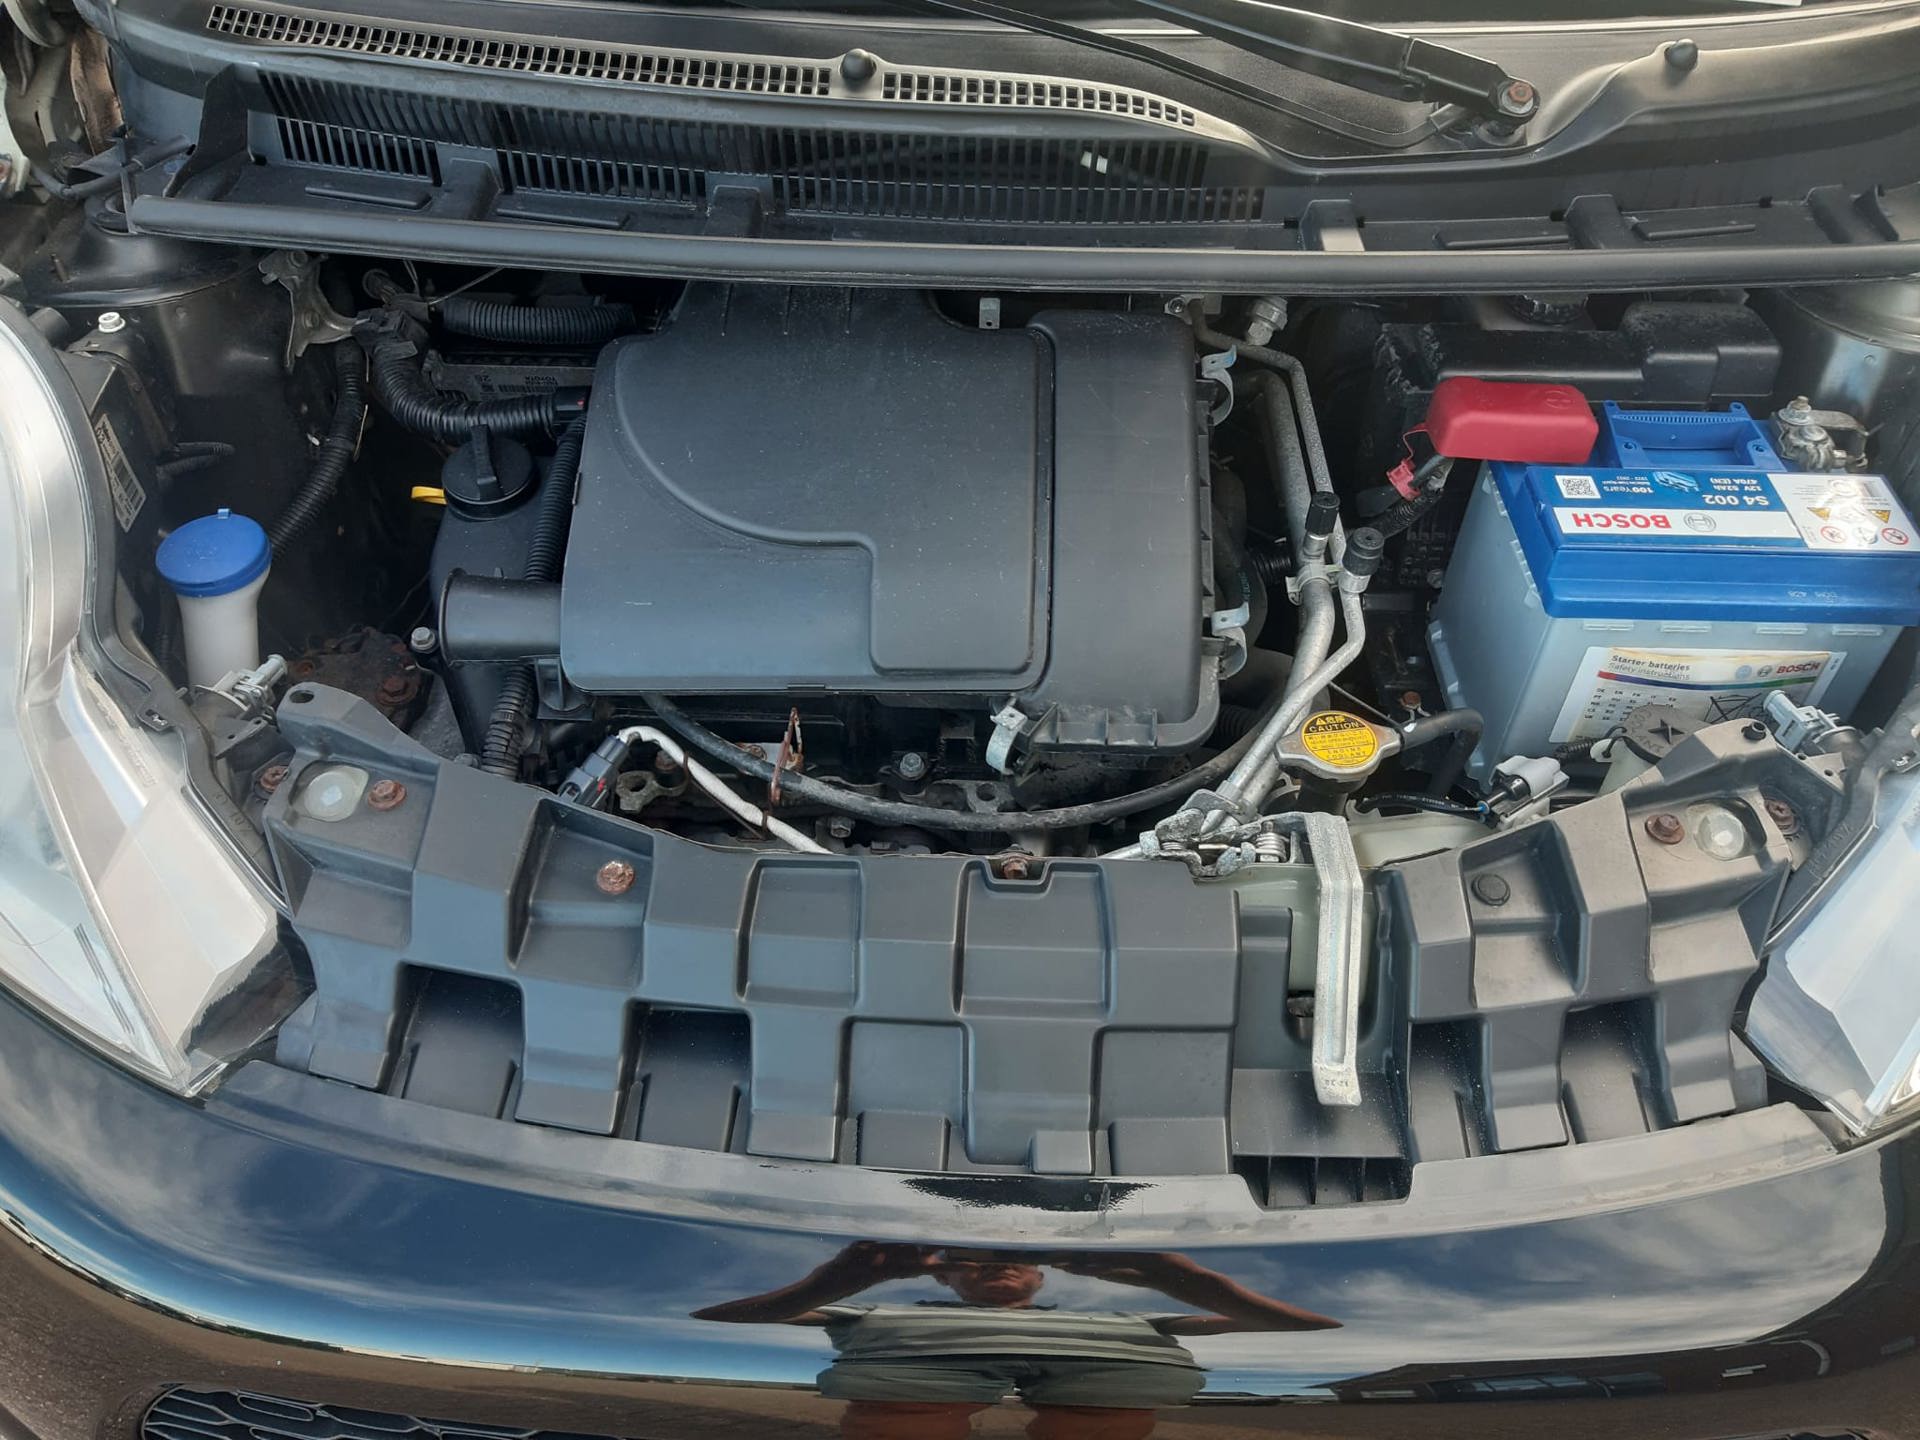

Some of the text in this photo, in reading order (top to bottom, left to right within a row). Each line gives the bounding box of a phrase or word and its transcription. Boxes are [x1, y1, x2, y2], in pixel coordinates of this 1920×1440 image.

[1602, 486, 1654, 494] 100 Years
[1744, 484, 1763, 492] 12V
[1702, 494, 1770, 506] S4 002
[1573, 512, 1672, 529] BOSCH
[1611, 655, 1690, 671] Starter batteries
[1776, 662, 1821, 674] BOSCH
[1608, 662, 1690, 680] Safety instructions
[1309, 722, 1359, 732] CAUTION
